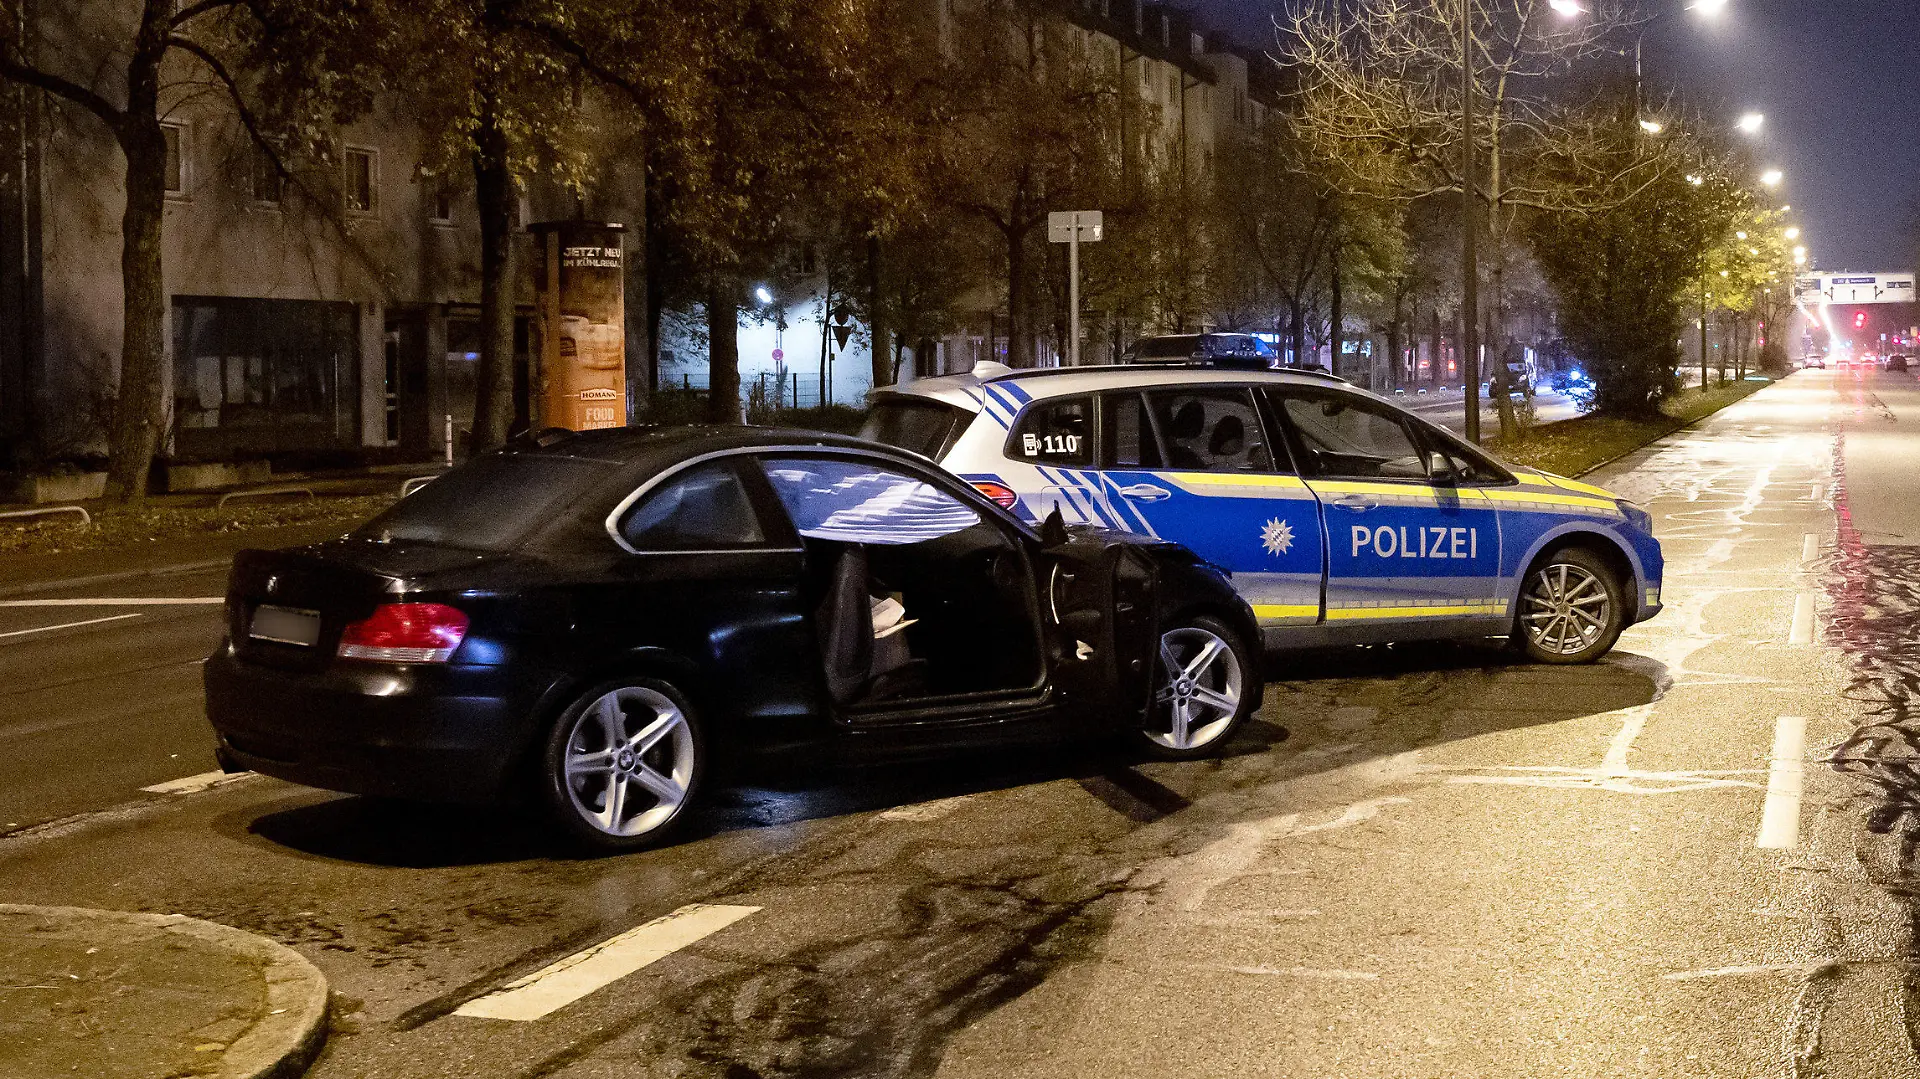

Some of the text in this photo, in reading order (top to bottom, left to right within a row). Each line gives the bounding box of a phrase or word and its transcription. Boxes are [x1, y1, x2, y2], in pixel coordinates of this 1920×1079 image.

[563, 247, 621, 258] JETZT NEU
[586, 407, 614, 421] FOOD
[1043, 435, 1077, 453] 110
[1351, 525, 1477, 559] POLIZEI
